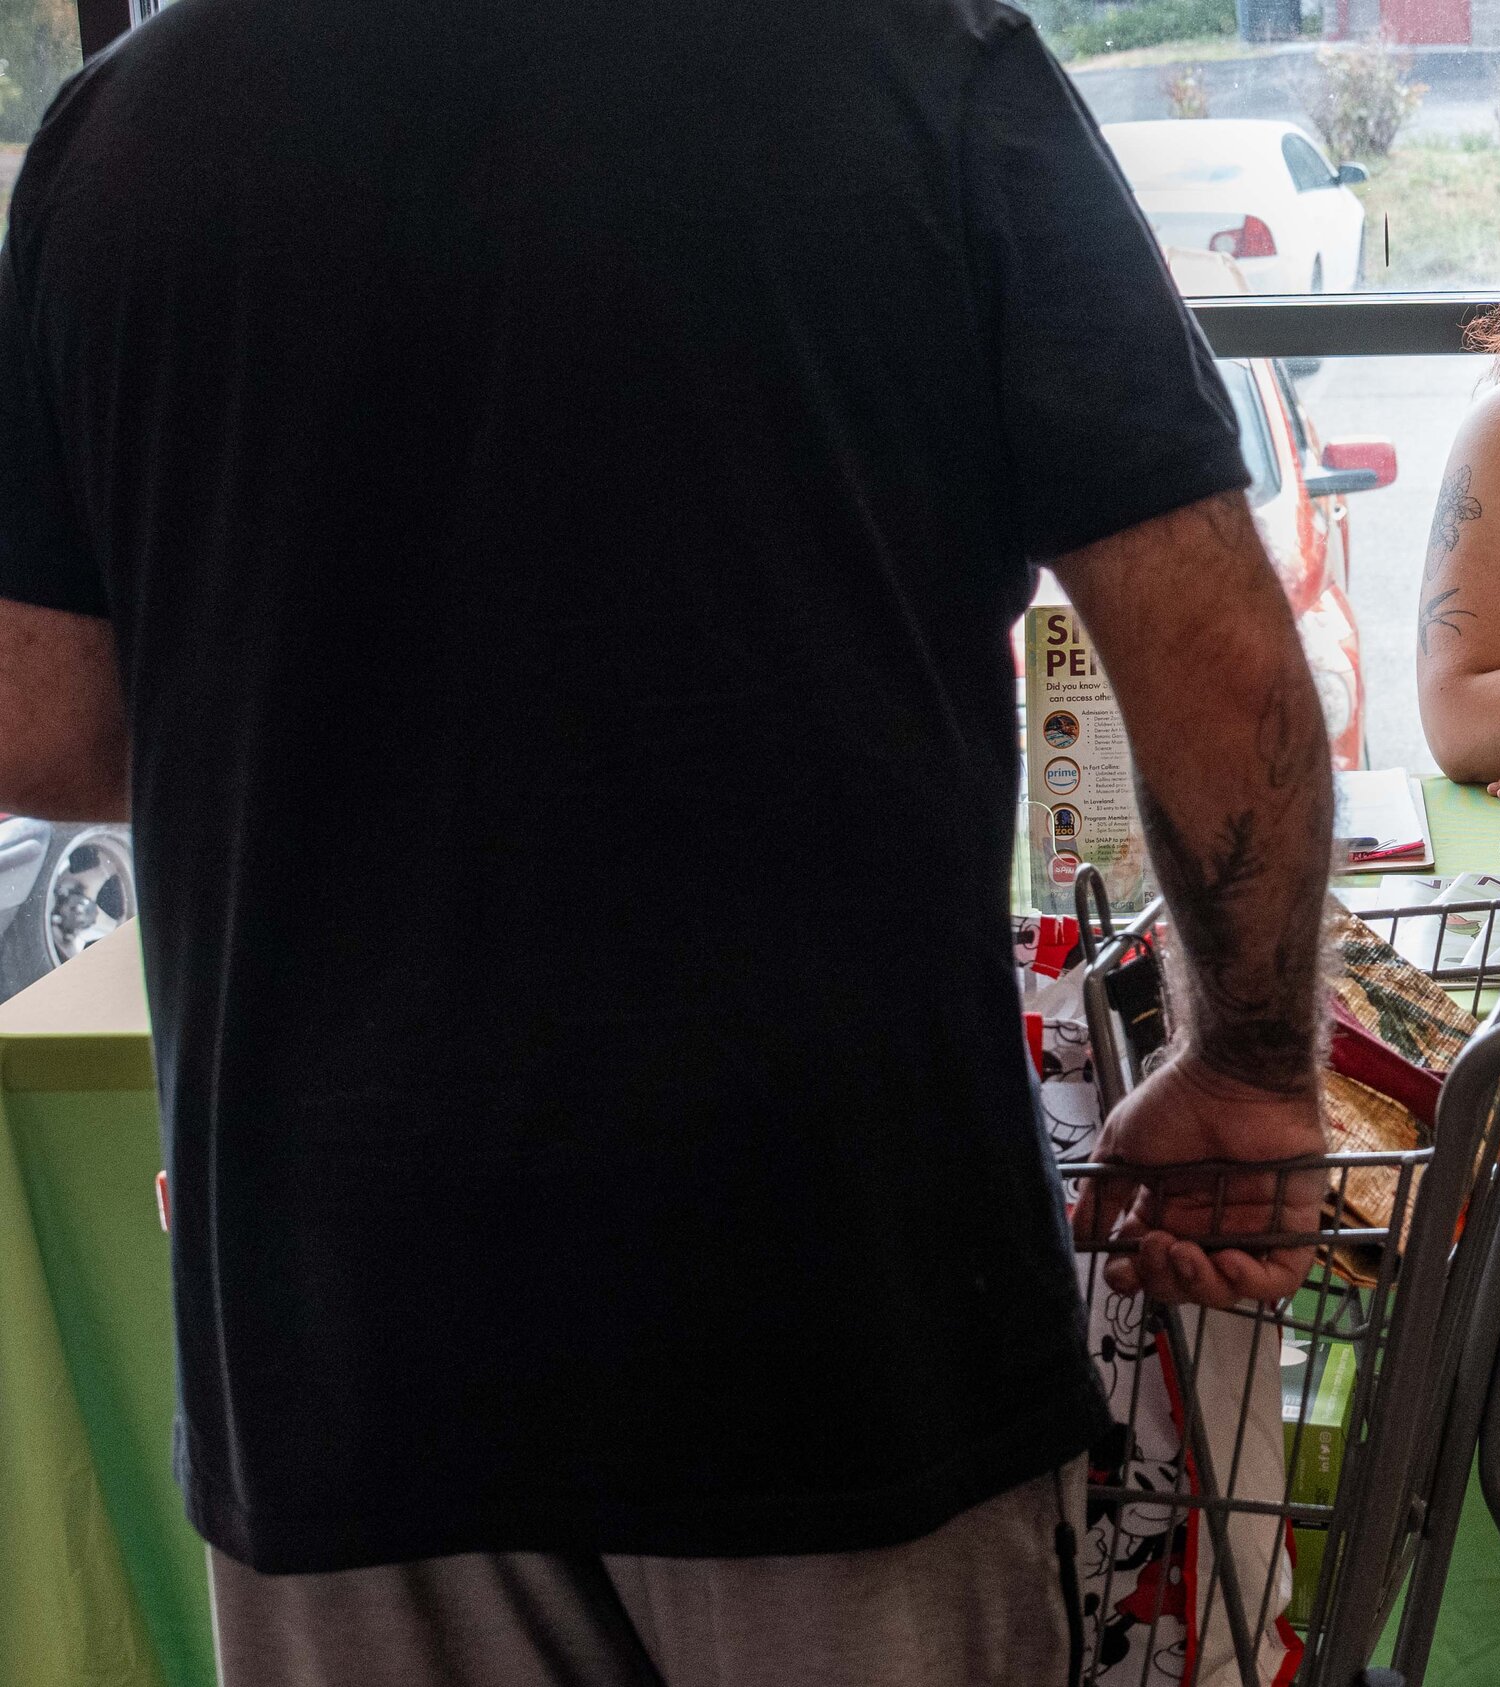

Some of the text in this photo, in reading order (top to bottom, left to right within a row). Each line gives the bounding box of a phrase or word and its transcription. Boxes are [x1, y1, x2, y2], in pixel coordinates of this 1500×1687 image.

[1046, 682, 1060, 691] Did
[1062, 684, 1077, 692] you
[1079, 681, 1101, 690] know
[1047, 768, 1077, 779] prime
